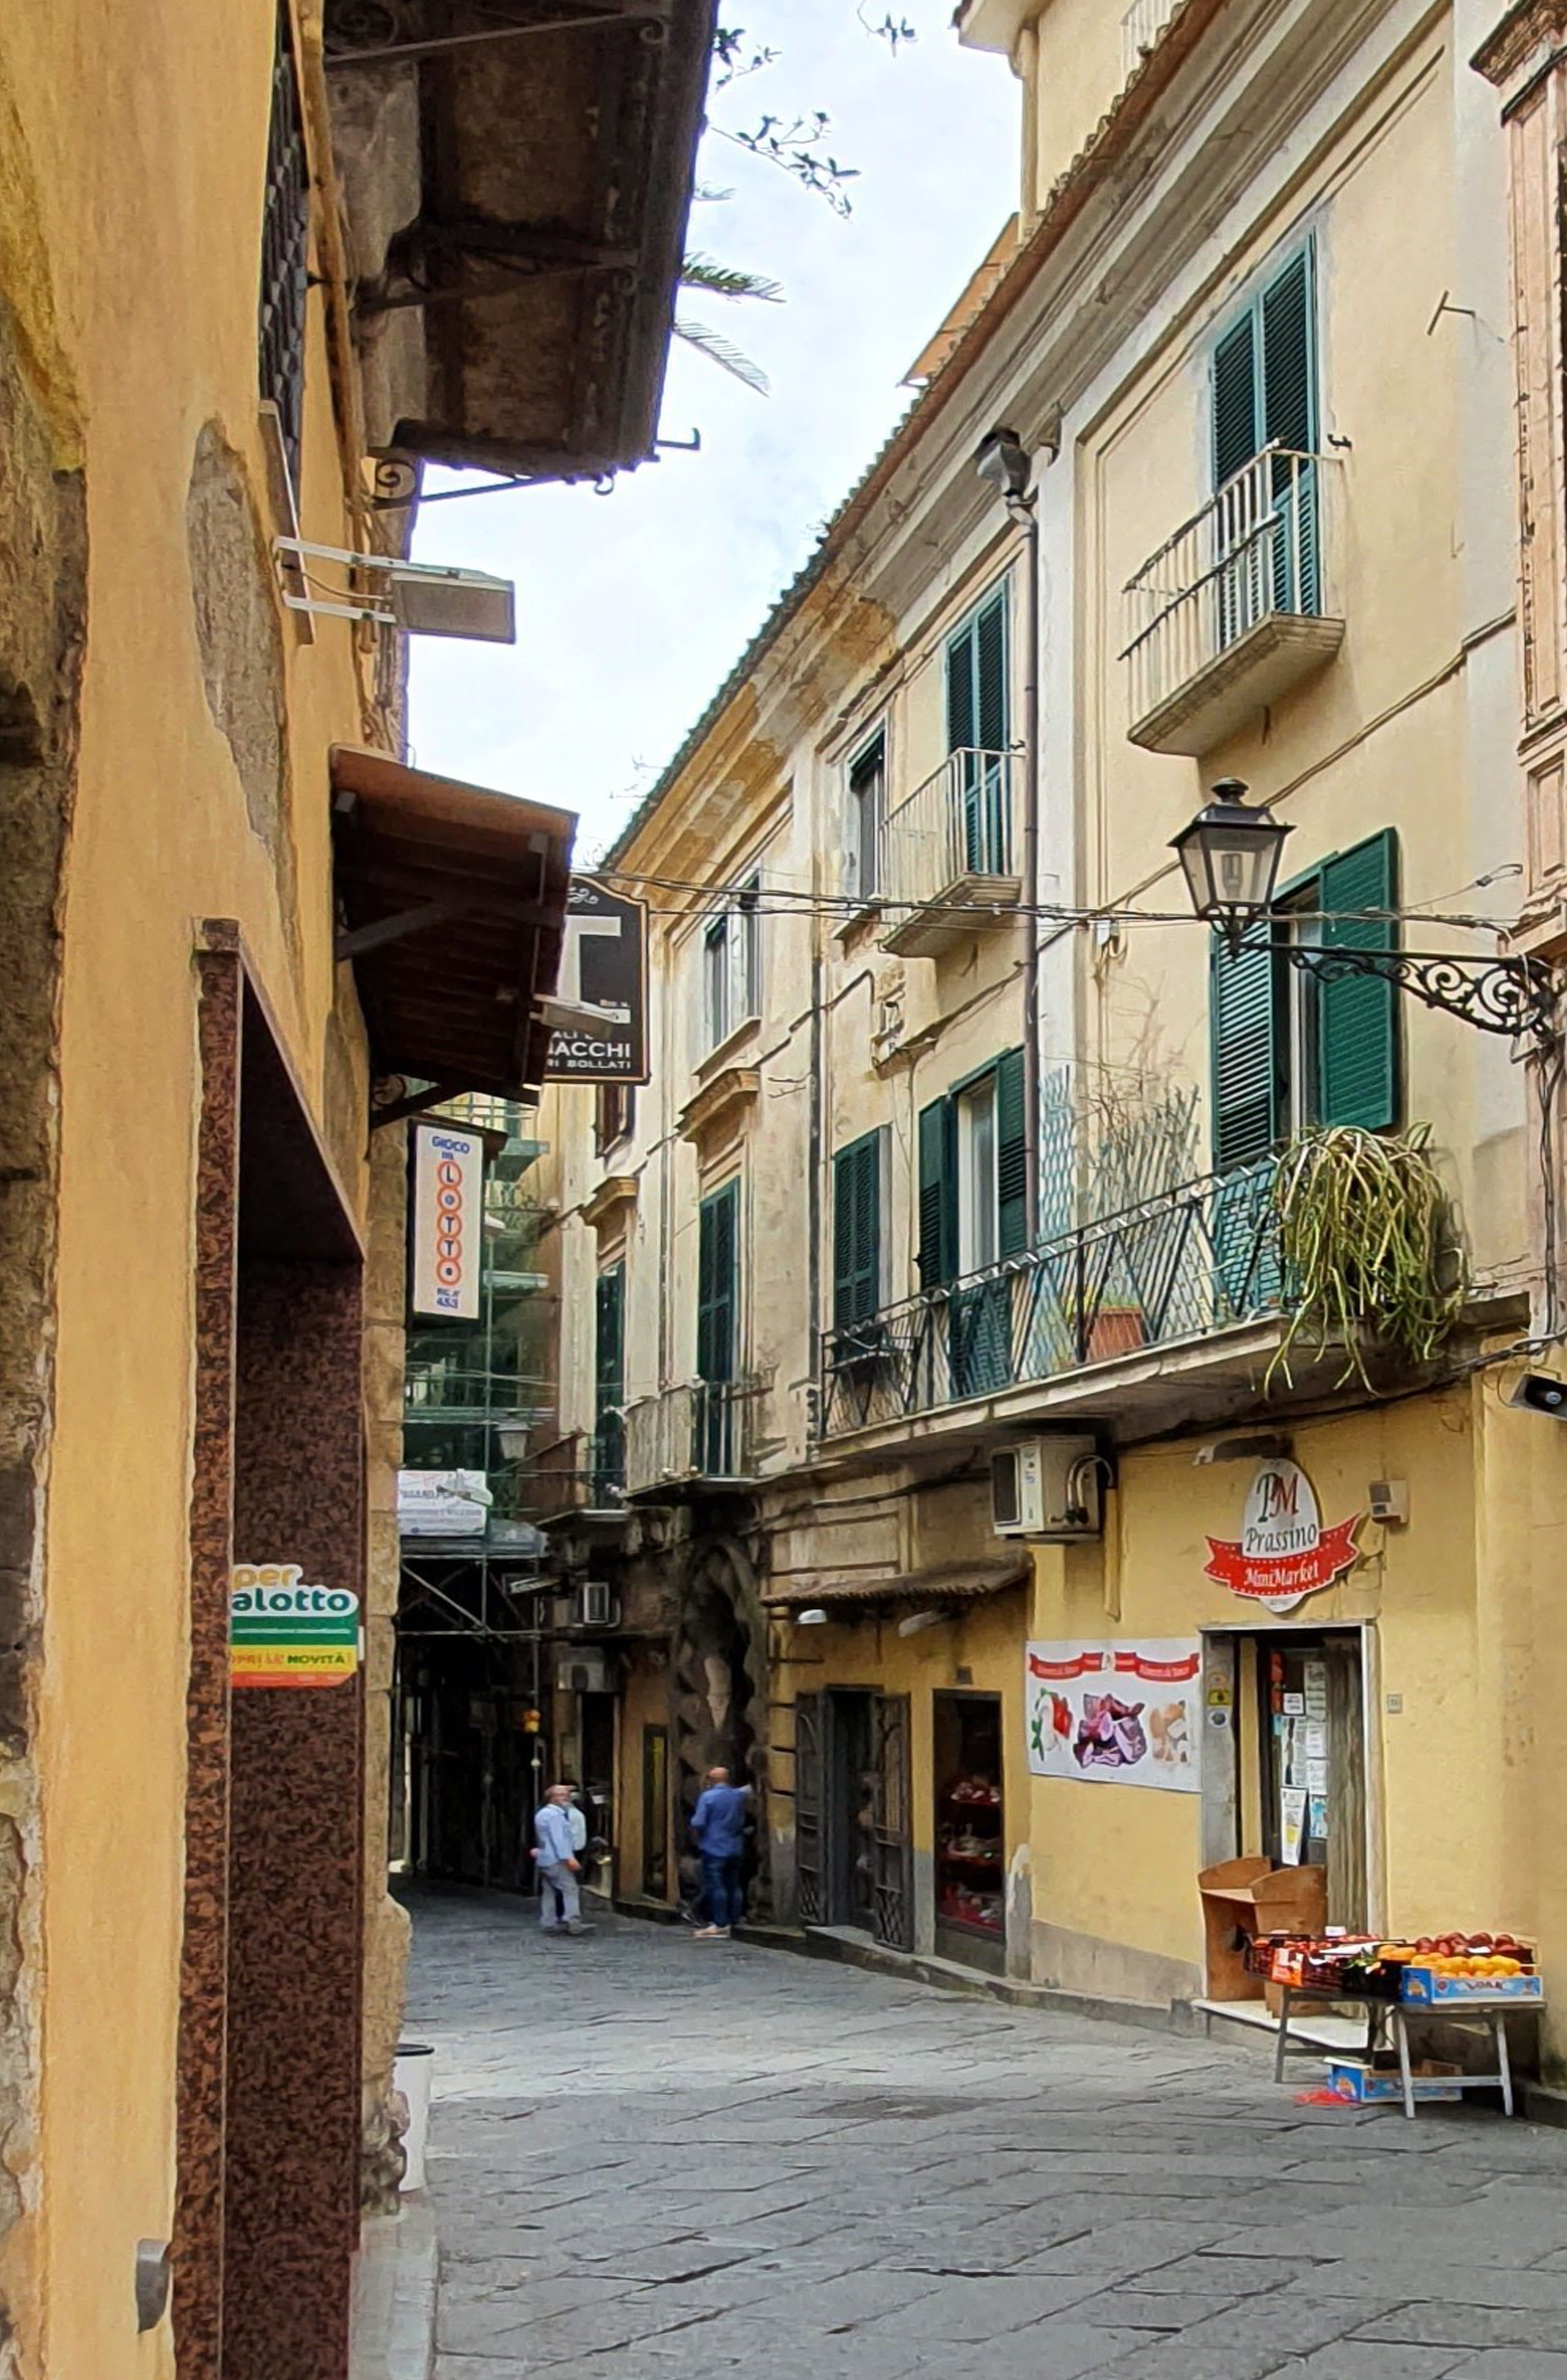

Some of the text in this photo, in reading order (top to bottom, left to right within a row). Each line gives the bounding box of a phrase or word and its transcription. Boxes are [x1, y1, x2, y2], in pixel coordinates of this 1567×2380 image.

[567, 1059, 631, 1069] BOLLATI
[432, 1136, 470, 1154] GIOCO
[1246, 1522, 1316, 1552] Prassino
[233, 1569, 294, 1589] per
[232, 1588, 350, 1611] alotto
